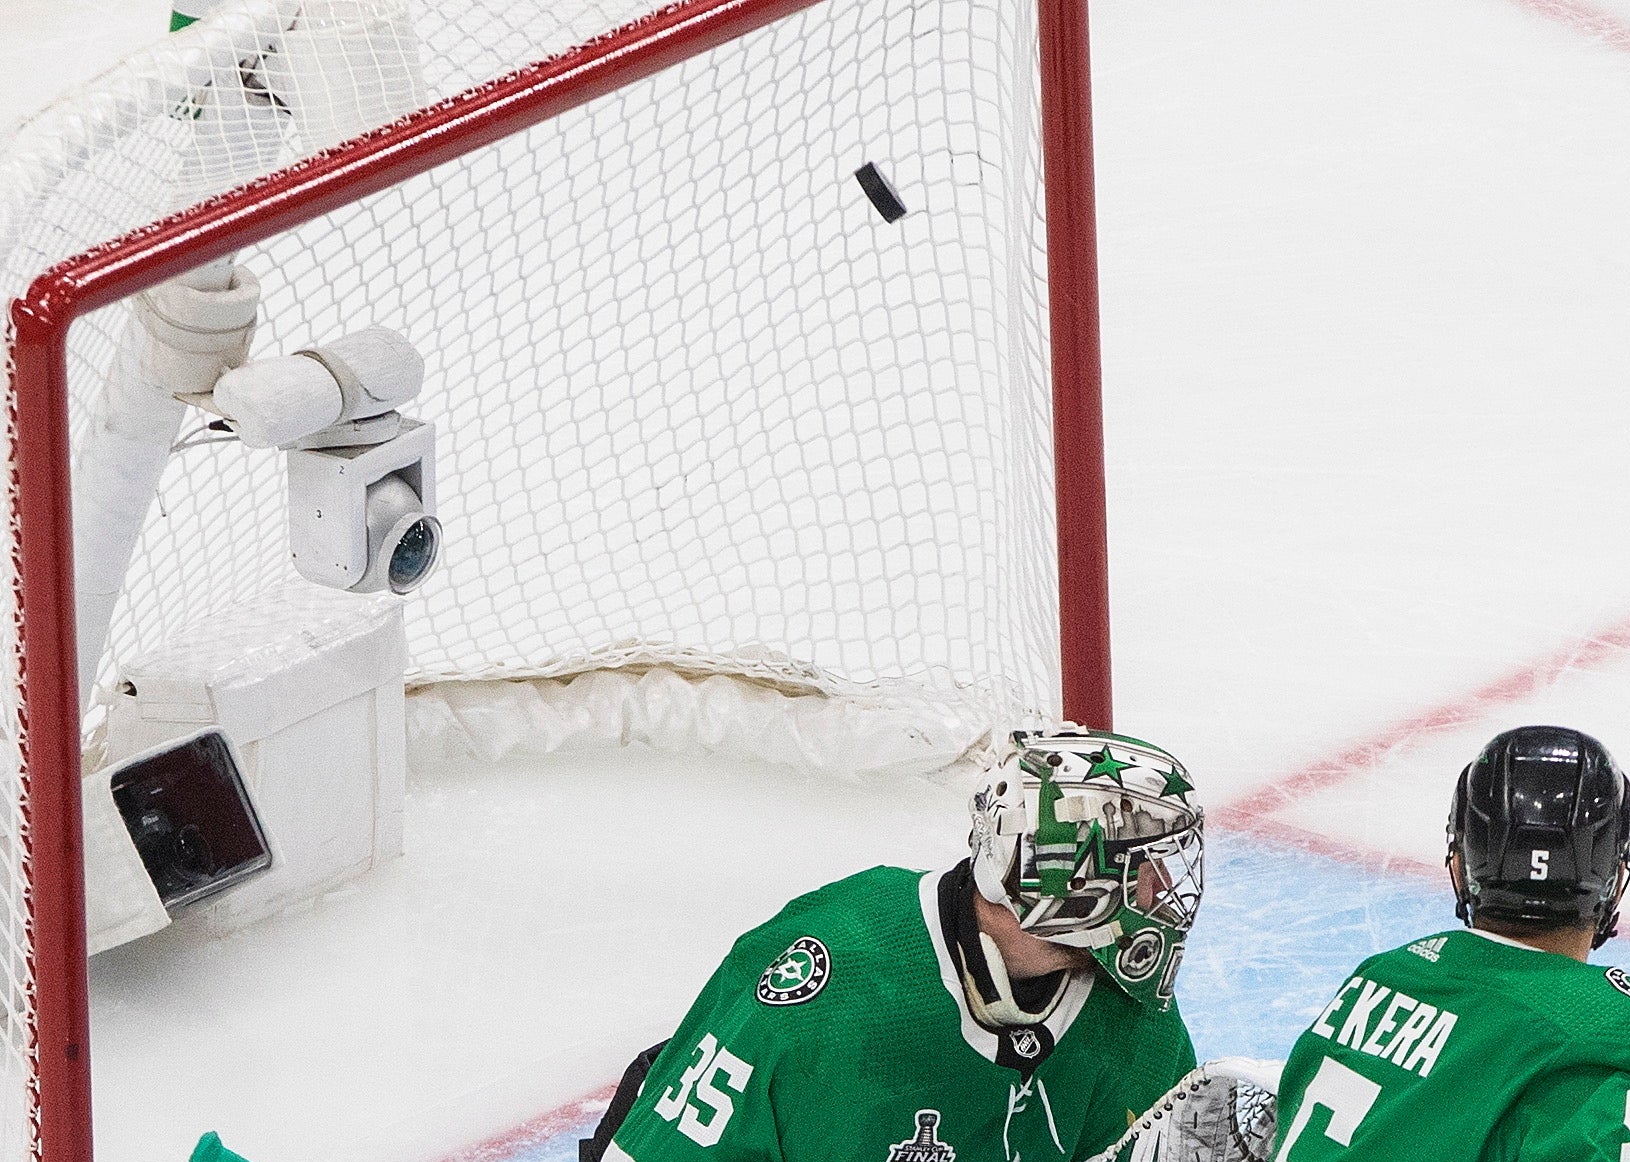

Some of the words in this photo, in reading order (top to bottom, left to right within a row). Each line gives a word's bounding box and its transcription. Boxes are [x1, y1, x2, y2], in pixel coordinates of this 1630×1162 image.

[1530, 850, 1549, 880] 5
[653, 1032, 754, 1148] 35
[894, 1151, 952, 1162] FINAL
